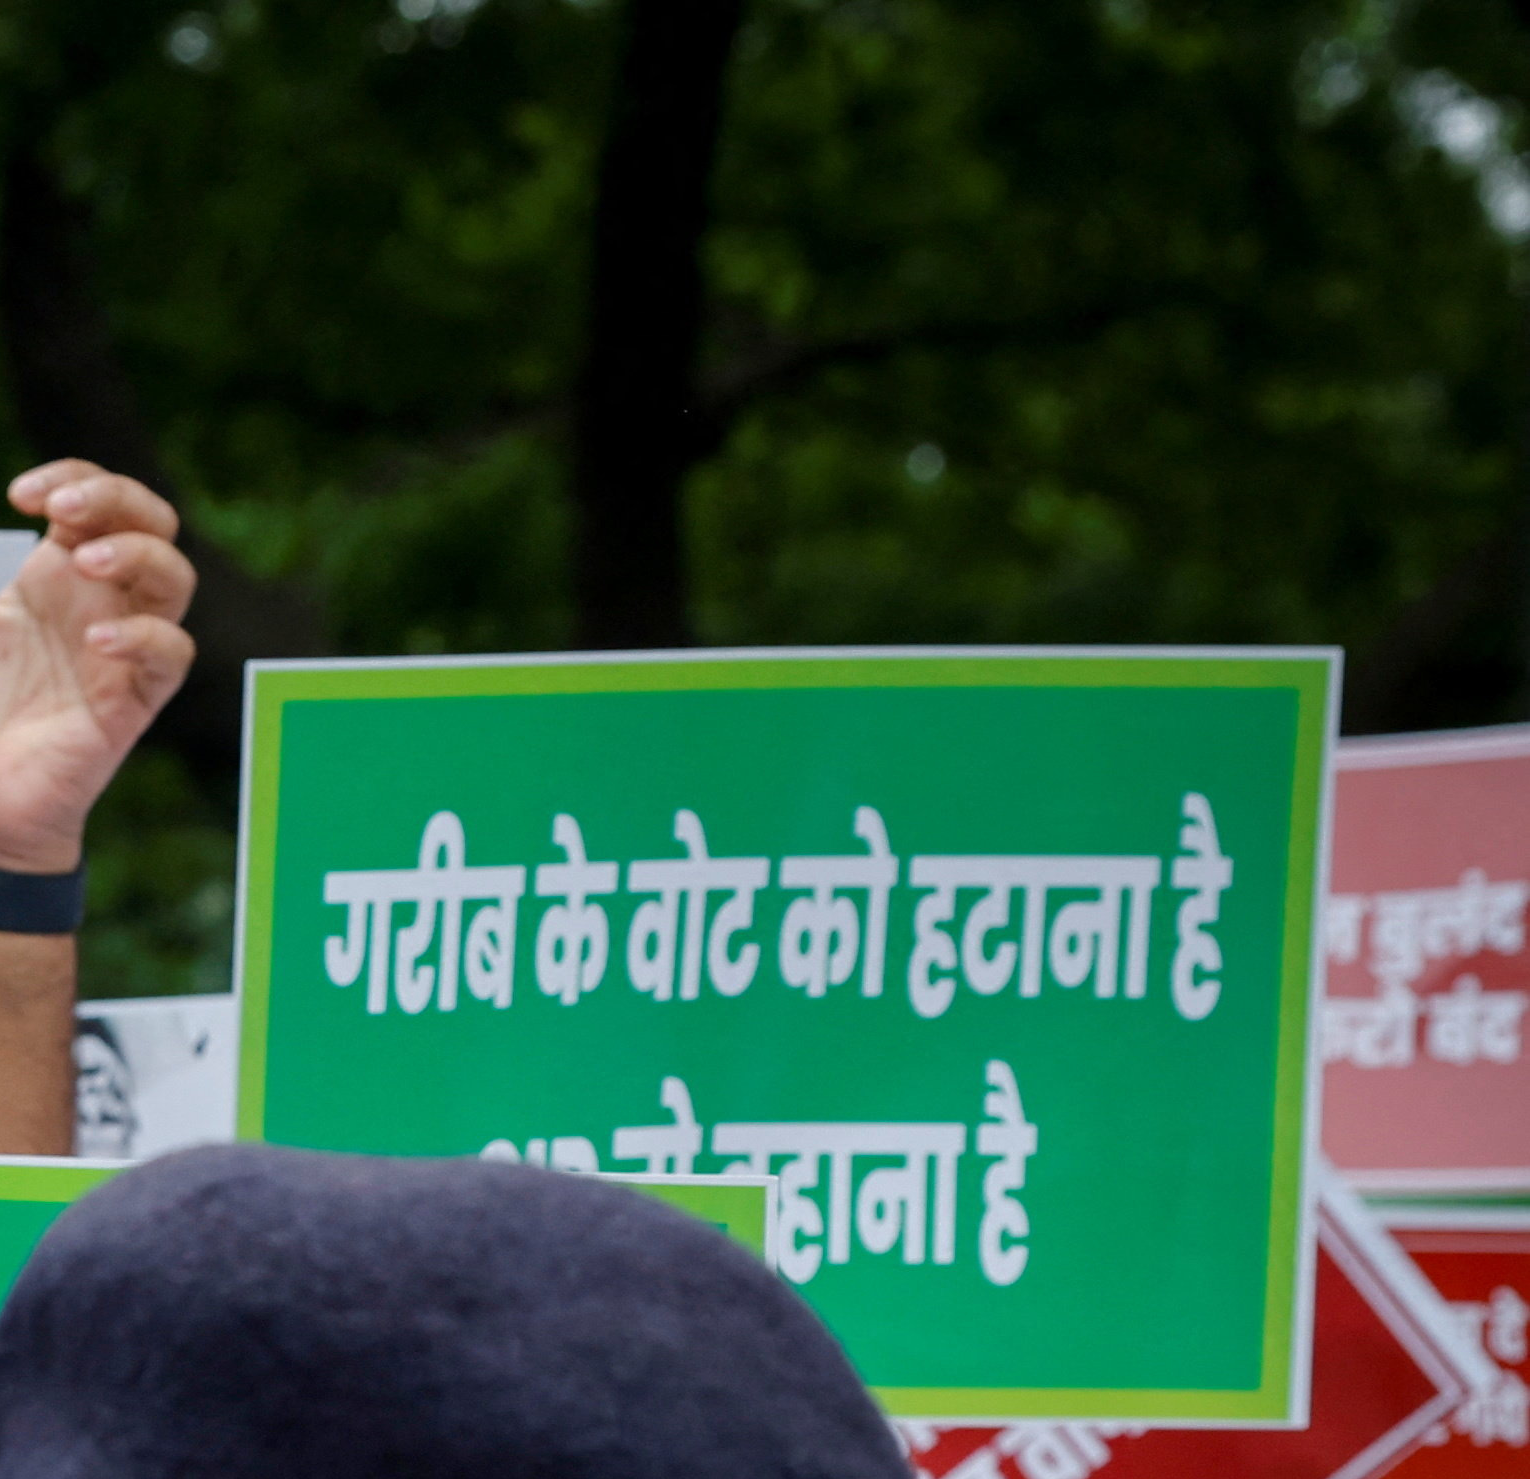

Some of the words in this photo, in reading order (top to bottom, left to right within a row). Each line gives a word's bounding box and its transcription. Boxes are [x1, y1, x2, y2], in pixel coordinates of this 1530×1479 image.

[323, 811, 526, 1014] गरीब
[534, 813, 618, 1007] के
[626, 809, 770, 1003] वोट
[779, 805, 898, 999] को
[907, 854, 1161, 1019] हटाना
[1168, 791, 1234, 1021] है
[712, 1122, 966, 1285] हाना
[977, 1060, 1038, 1286] है
